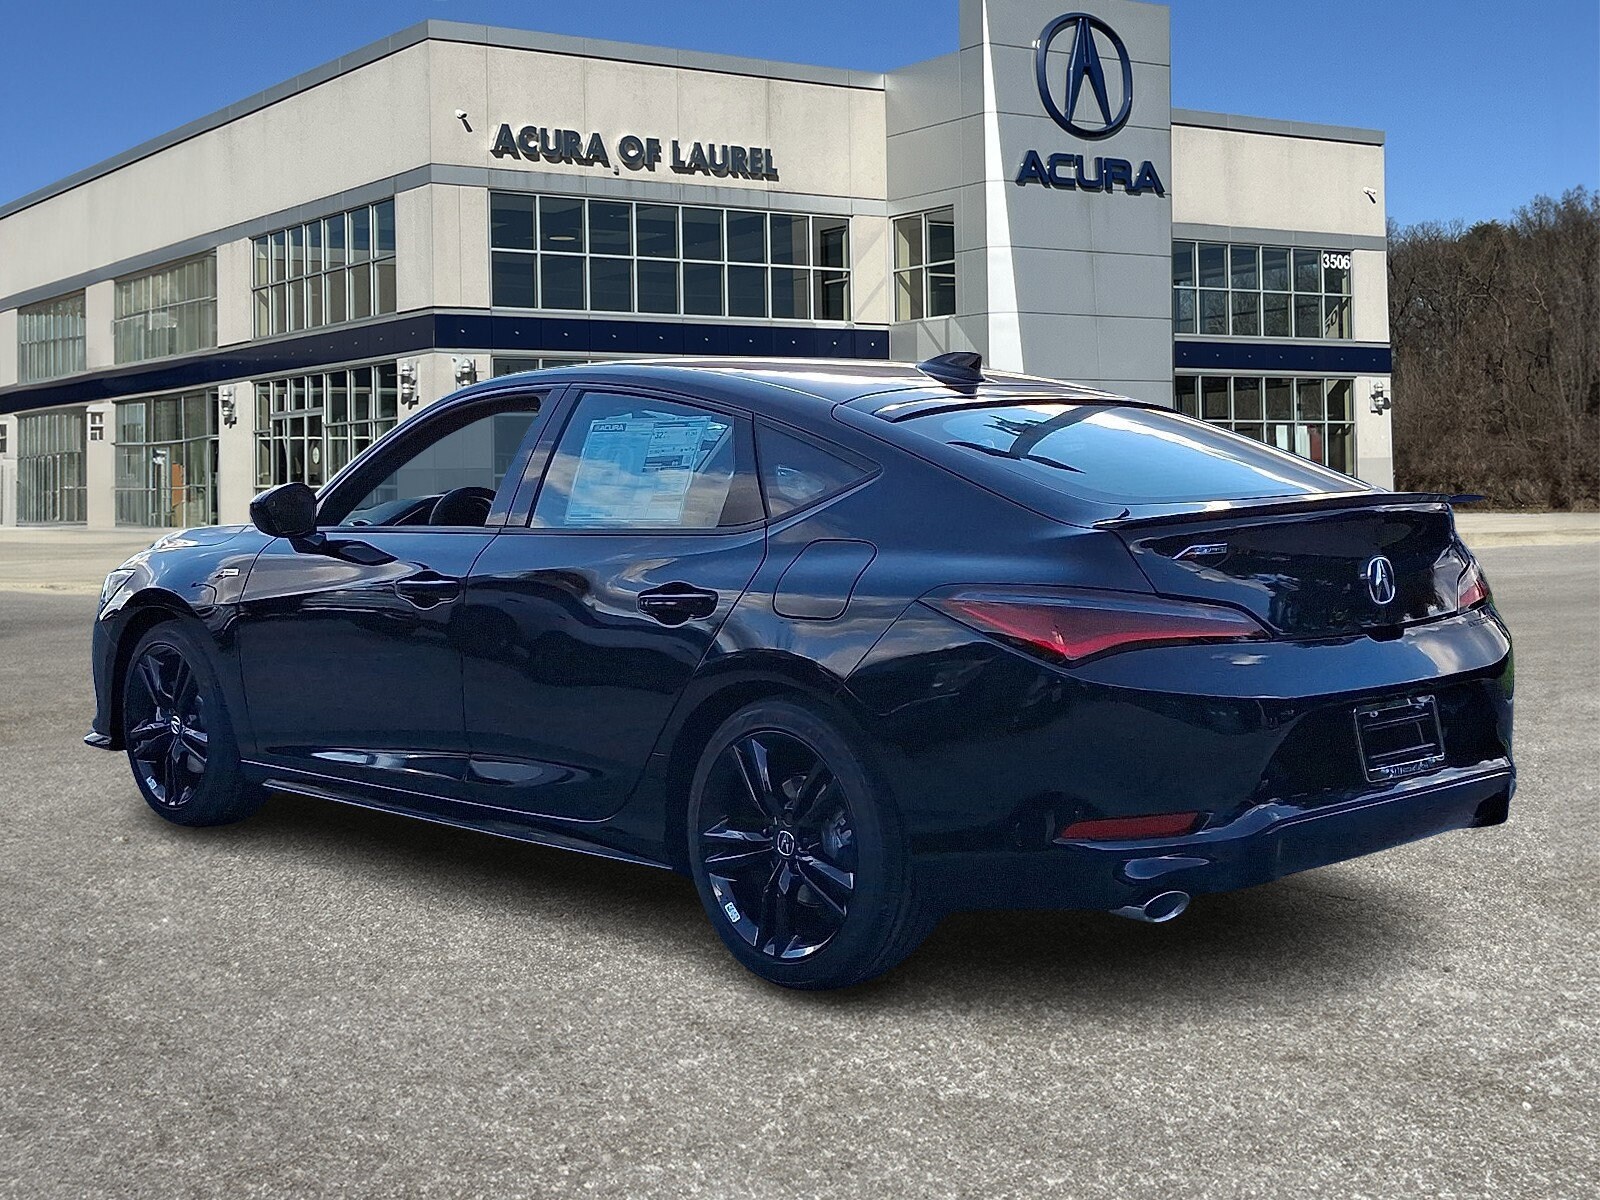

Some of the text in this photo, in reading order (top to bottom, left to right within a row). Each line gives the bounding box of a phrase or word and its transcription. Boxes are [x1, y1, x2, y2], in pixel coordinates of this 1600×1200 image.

[492, 123, 778, 181] ACURA OF LAUREL
[1016, 150, 1165, 197] ACURA
[1323, 253, 1350, 269] 3506
